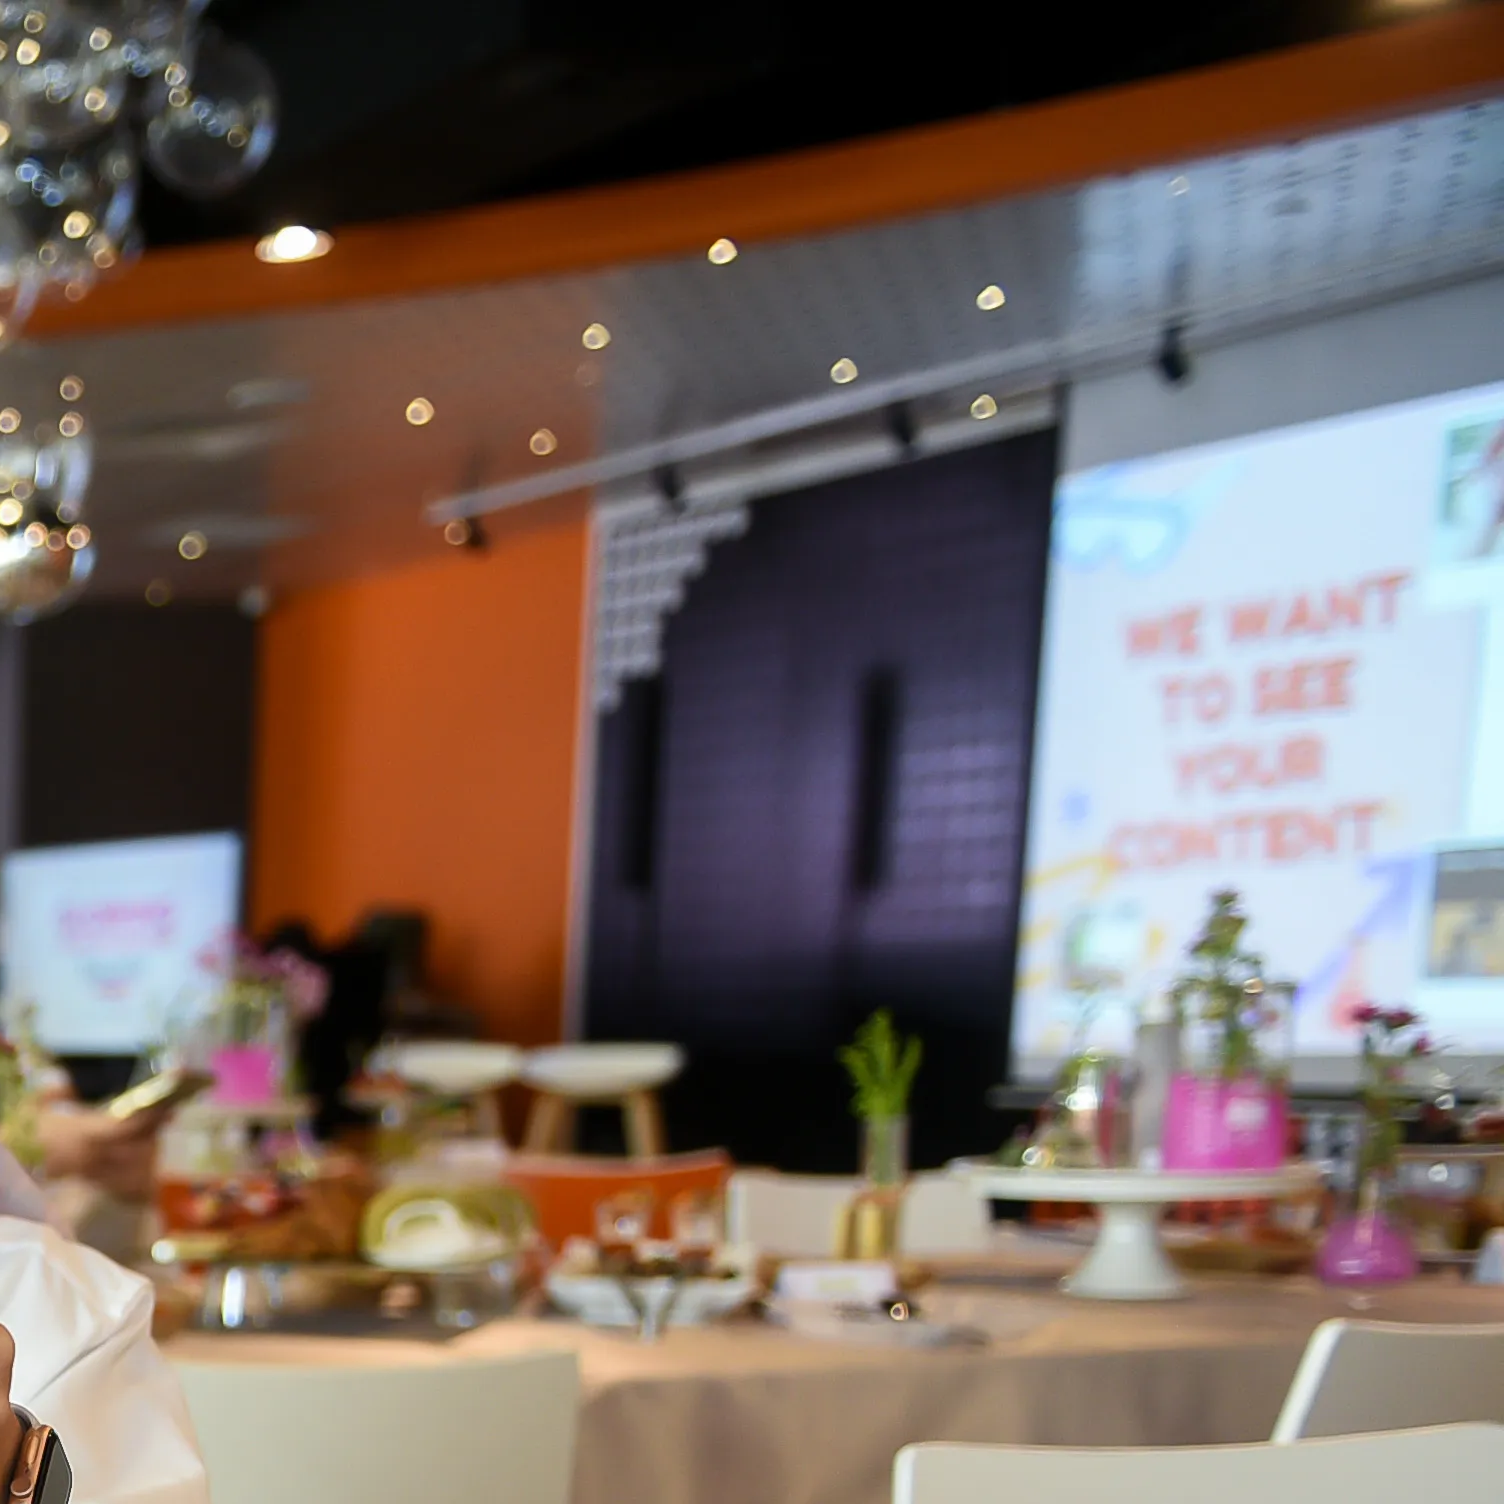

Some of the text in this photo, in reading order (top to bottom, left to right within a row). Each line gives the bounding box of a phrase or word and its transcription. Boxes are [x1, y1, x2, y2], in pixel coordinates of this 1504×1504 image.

[1124, 570, 1411, 657] WE WANT
[1159, 653, 1357, 724] TO SEE
[1173, 733, 1326, 792] YOUR
[1108, 798, 1384, 872] CONTENT
